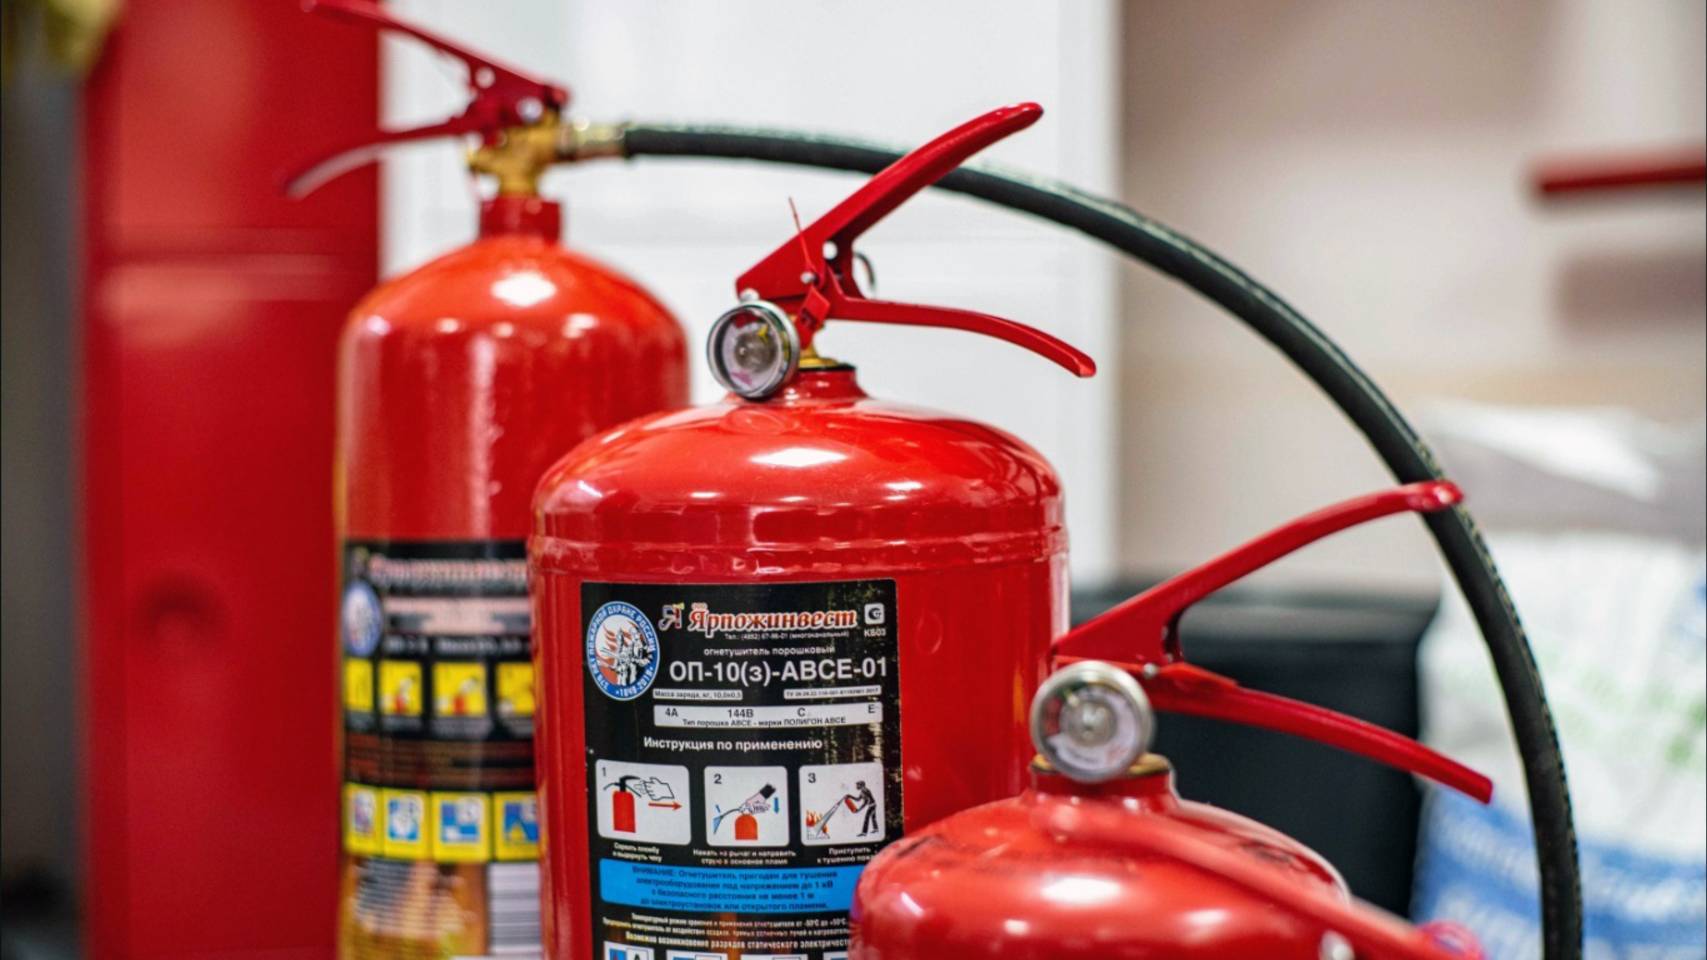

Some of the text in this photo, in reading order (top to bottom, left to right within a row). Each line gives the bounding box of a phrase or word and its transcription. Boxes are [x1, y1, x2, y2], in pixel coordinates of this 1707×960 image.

[688, 609, 857, 638] Ярпожинвест
[704, 645, 835, 657] огнетушитель порошковый
[669, 657, 887, 687] ОП-10(з)-АВСЕ-01
[655, 690, 675, 698] Масса
[665, 704, 876, 718] 4А 144В С Е
[697, 720, 729, 728] порошка
[730, 719, 750, 727] АВСЕ
[758, 720, 782, 728] марки
[784, 717, 823, 726] ПОЛИГОН
[825, 716, 847, 724] АВСЕ
[643, 736, 823, 752] Инструкция по применению
[602, 767, 606, 776] 1
[714, 774, 722, 784] 2
[808, 773, 816, 783] 3
[758, 850, 796, 858] направить
[828, 847, 871, 856] Приступить
[678, 870, 737, 880] Огнетушитель
[747, 940, 798, 950] статического
[800, 939, 849, 949] электричест
